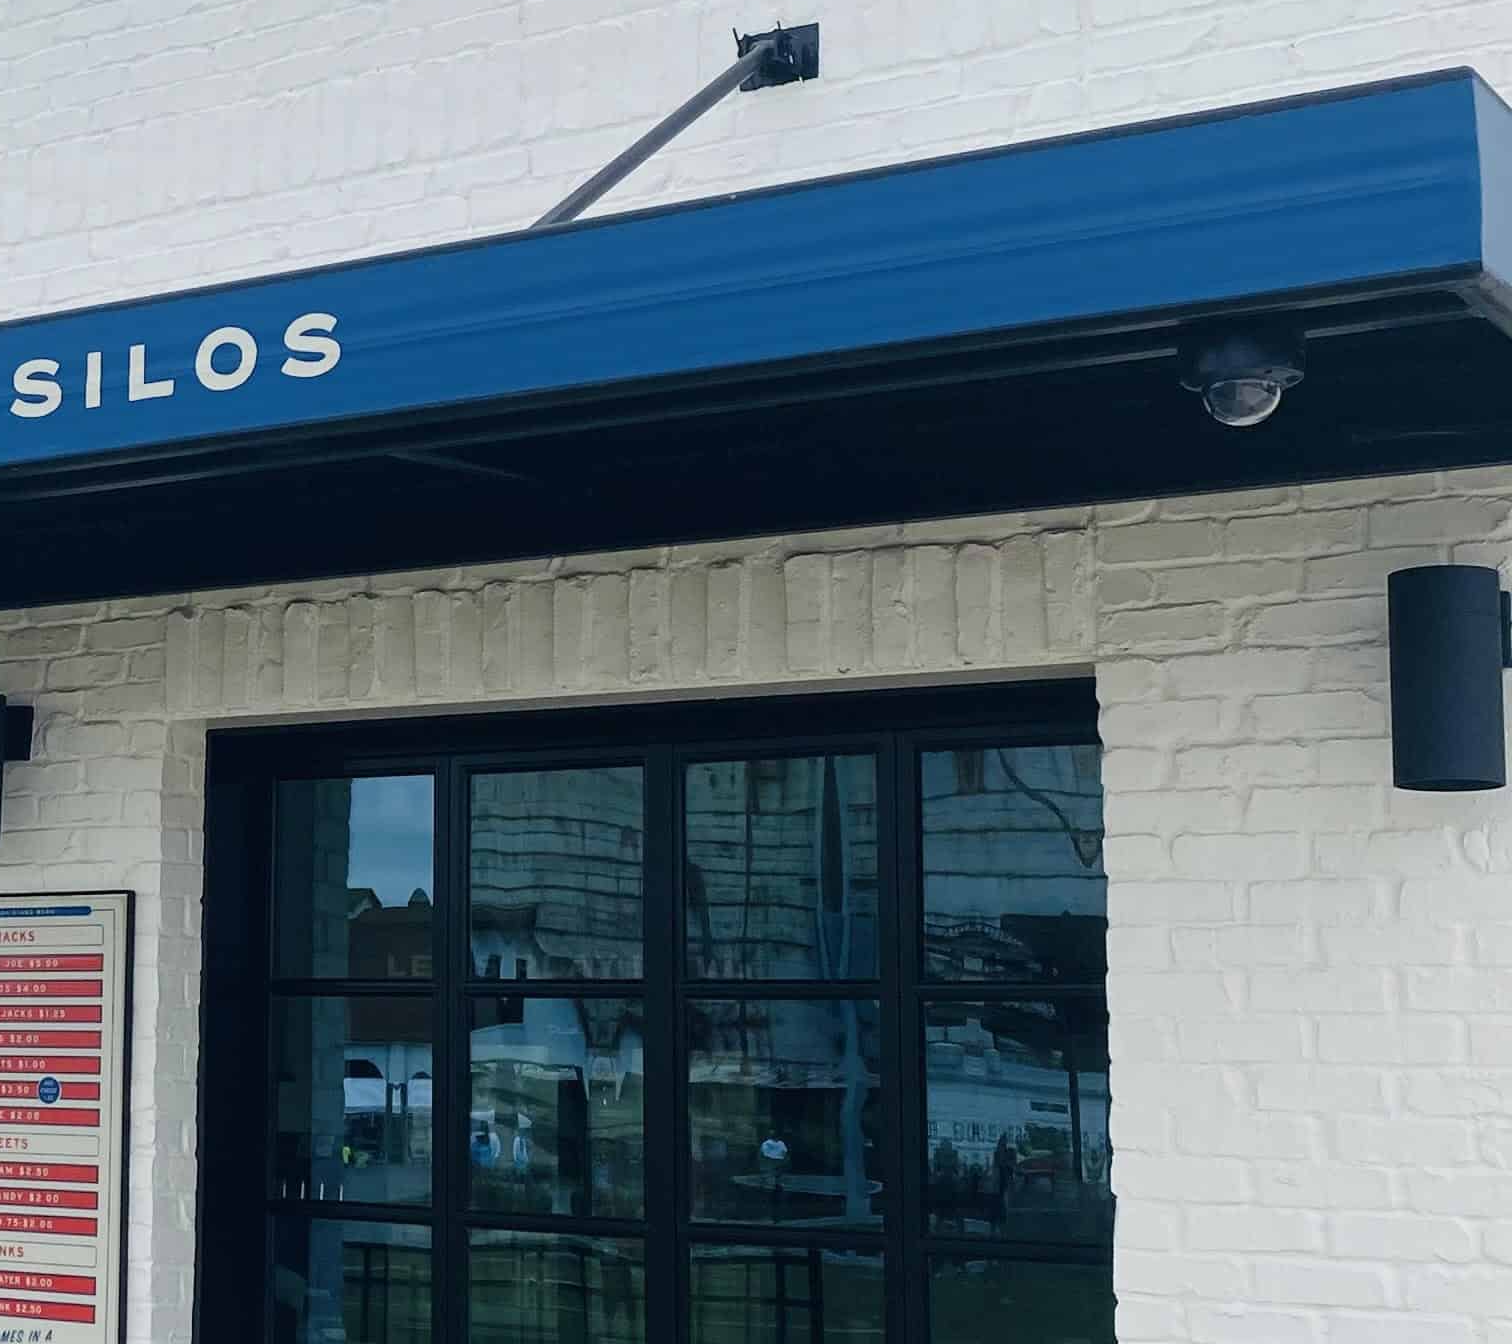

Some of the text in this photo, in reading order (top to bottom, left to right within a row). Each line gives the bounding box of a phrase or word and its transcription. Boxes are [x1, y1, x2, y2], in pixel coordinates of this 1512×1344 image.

[8, 312, 343, 420] SILOS
[5, 959, 24, 968] JOE
[0, 1009, 33, 1018] JACKS
[28, 1329, 41, 1342] IN
[45, 1329, 53, 1342] A
